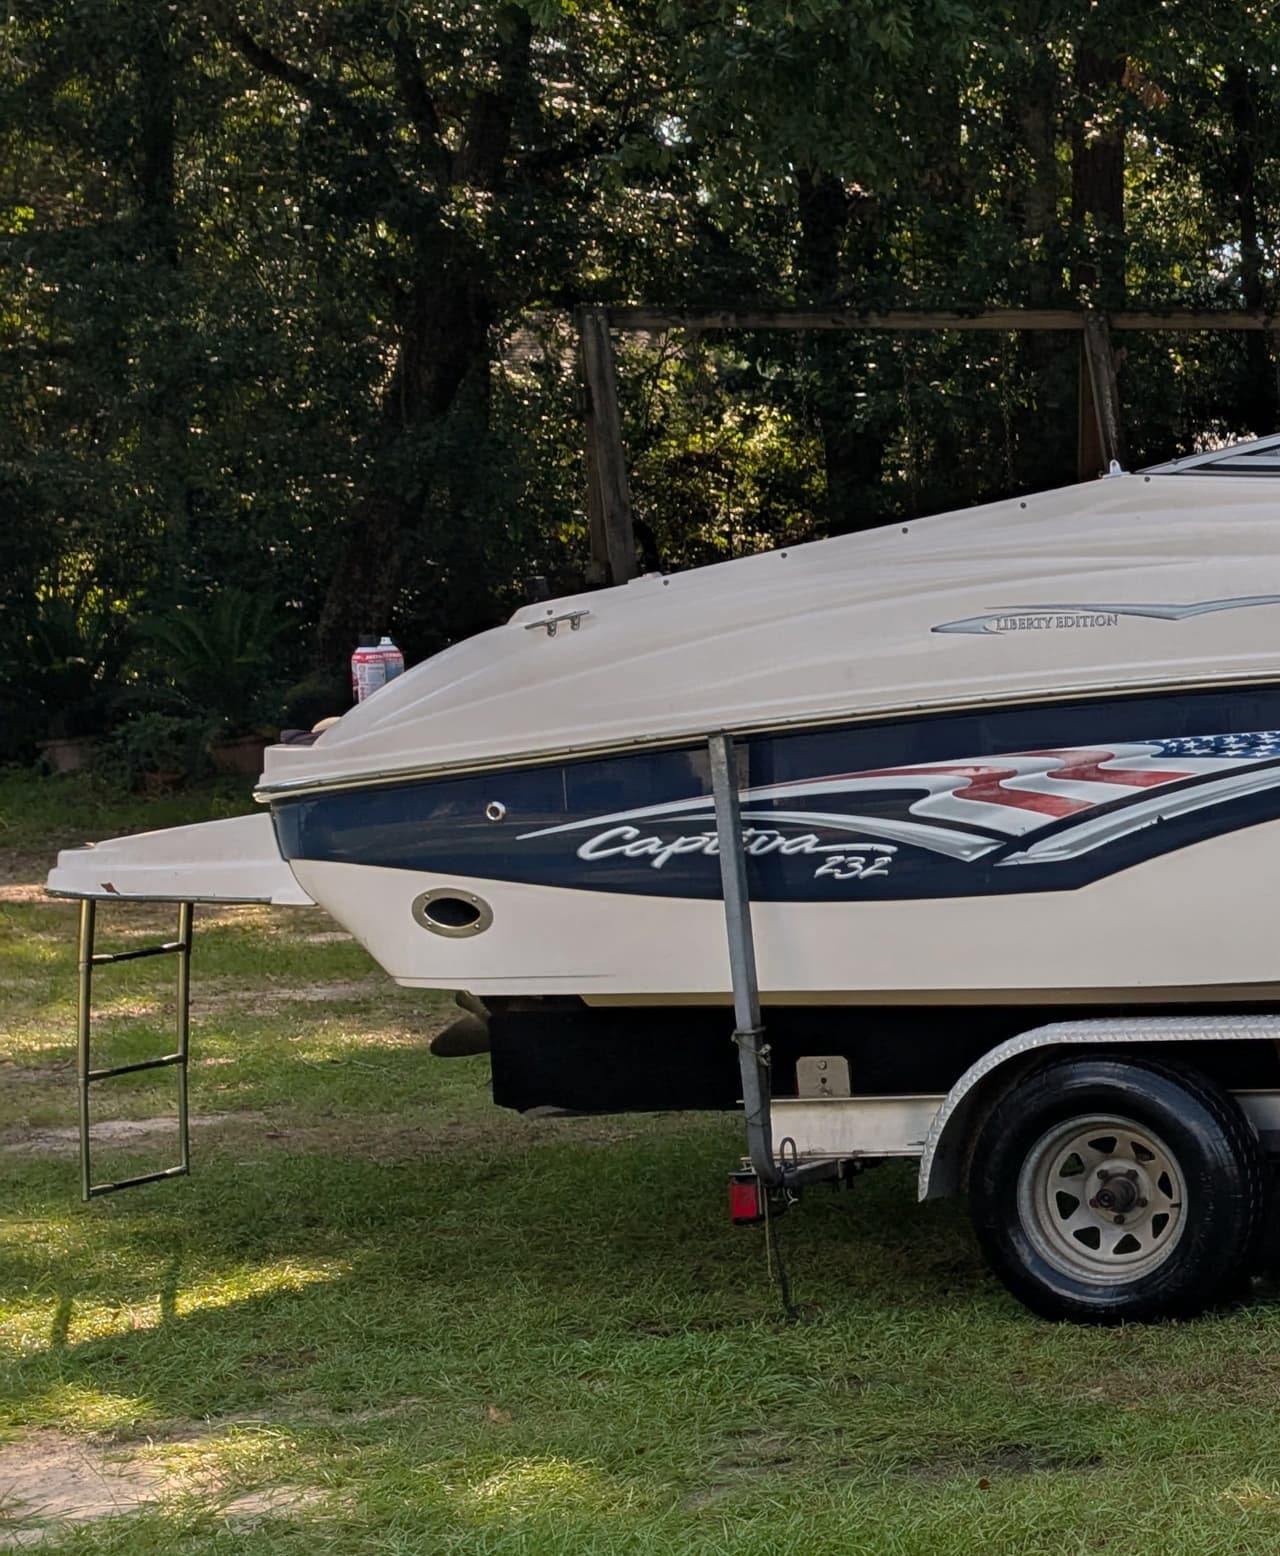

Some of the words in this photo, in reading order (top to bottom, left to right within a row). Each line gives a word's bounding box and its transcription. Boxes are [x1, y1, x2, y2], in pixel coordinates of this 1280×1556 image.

[996, 616, 1053, 631] LIBERTY
[1056, 614, 1119, 629] EDITION
[577, 826, 897, 868] Captva
[814, 855, 892, 880] 232
